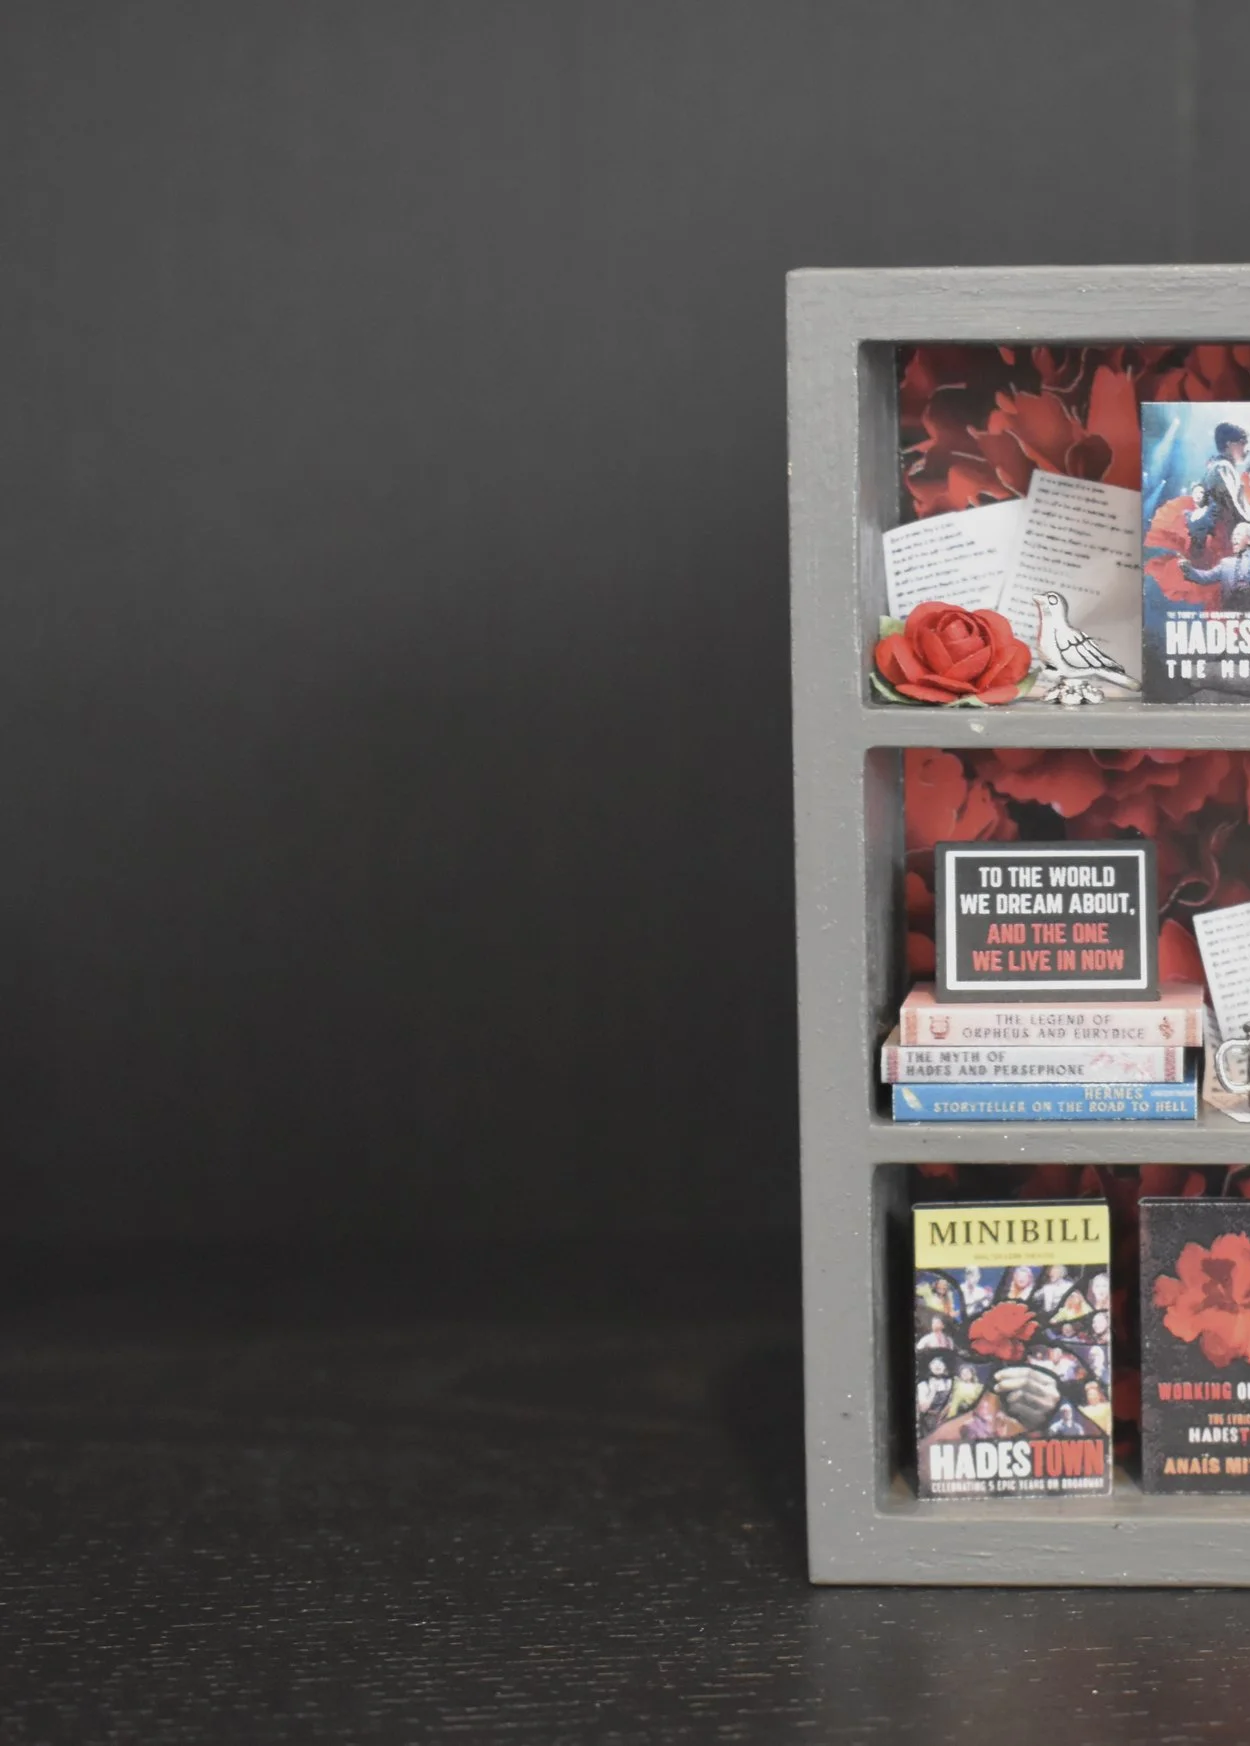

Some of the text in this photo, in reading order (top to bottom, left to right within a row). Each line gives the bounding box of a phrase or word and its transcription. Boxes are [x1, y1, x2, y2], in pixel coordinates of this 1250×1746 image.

[1166, 659, 1206, 679] THE
[978, 866, 1116, 888] TO THE WORLD
[960, 892, 1136, 916] WE DREAM ABOUT,
[986, 922, 1109, 944] AND THE ONE
[972, 949, 1125, 971] WE LIVE IN NOW
[995, 1014, 1112, 1025] THE LEGEND OF
[962, 1027, 1146, 1040] ORPHEUS AND EURYDICE
[906, 1051, 1006, 1063] THE MYTH OF
[906, 1065, 1085, 1076] HADES AND PERSEPHONE
[1084, 1087, 1144, 1100] HERMES
[933, 1101, 1189, 1113] STORYTELLER ON THE ROAD TO HELL
[929, 1217, 1100, 1246] MINIBILL
[1158, 1381, 1233, 1401] WORKING
[1207, 1413, 1224, 1425] THE
[929, 1439, 1105, 1480] HADESTOWN
[1163, 1453, 1221, 1475] ANAÏS
[997, 1480, 1017, 1492] EPIC
